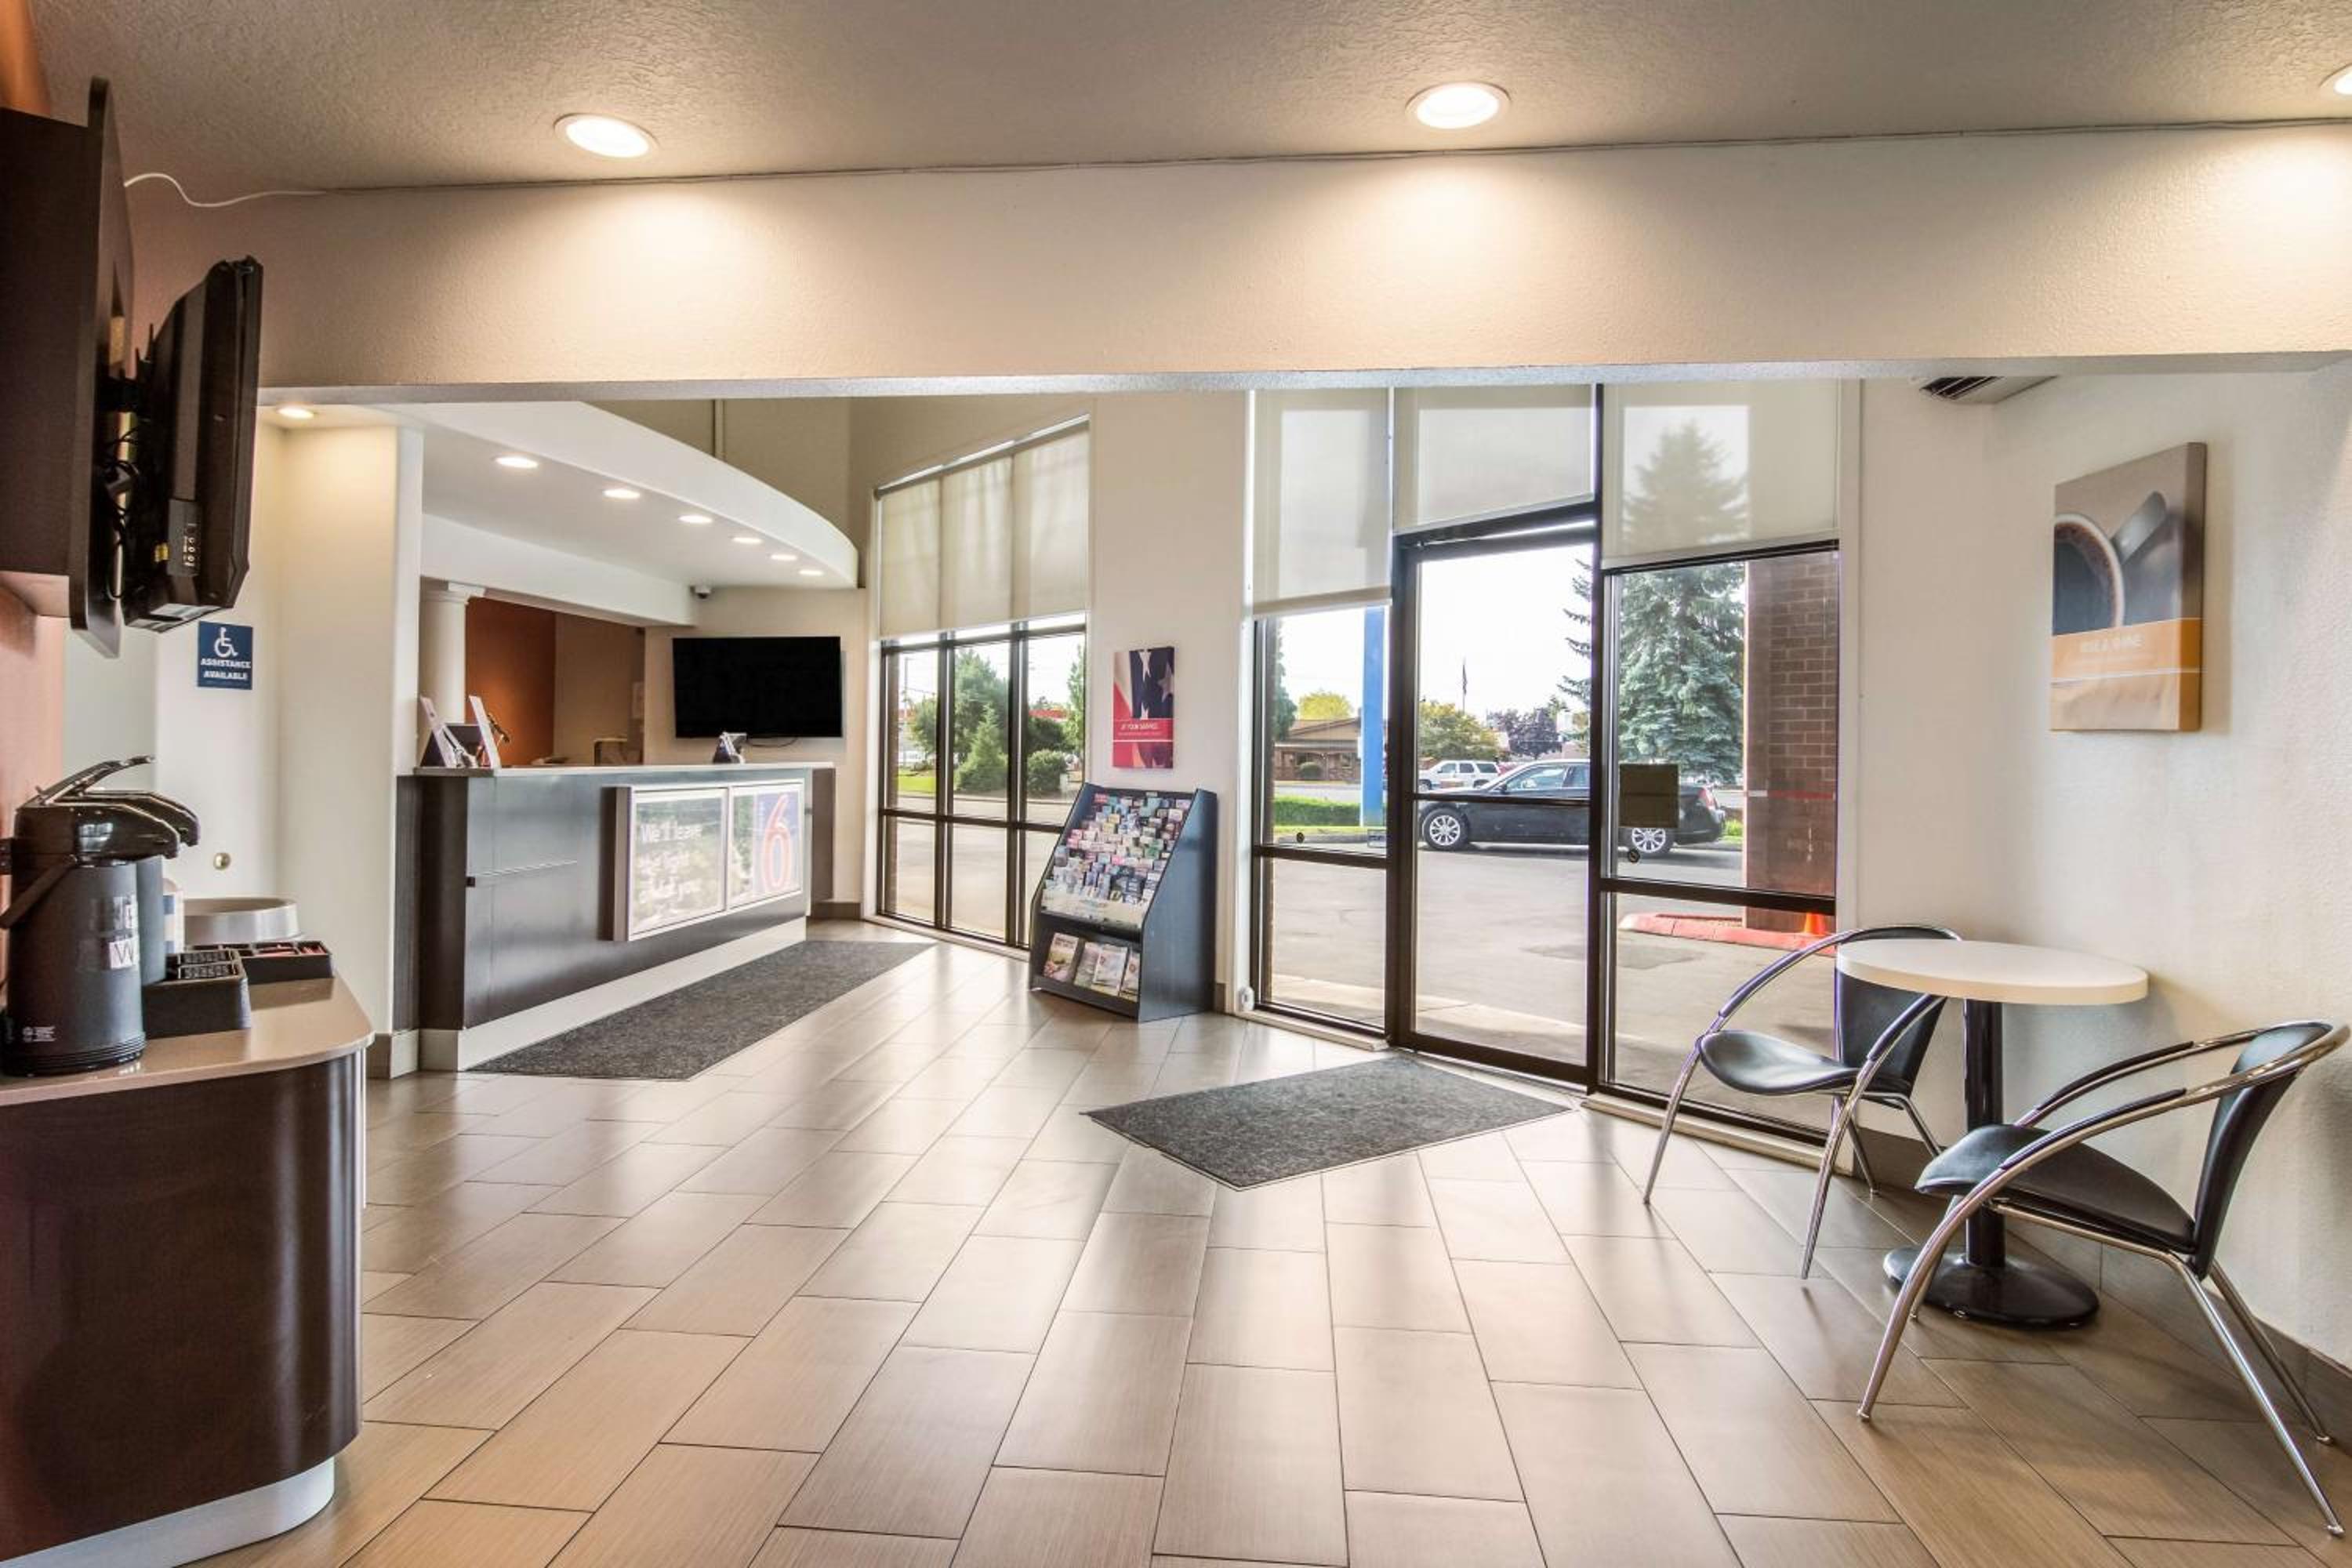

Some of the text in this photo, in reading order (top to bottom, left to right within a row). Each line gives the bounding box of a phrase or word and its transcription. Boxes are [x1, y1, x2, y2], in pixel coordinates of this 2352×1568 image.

[201, 658, 251, 669] ASSISTANCE
[204, 670, 248, 680] AVAILABLE
[763, 793, 791, 891] 6
